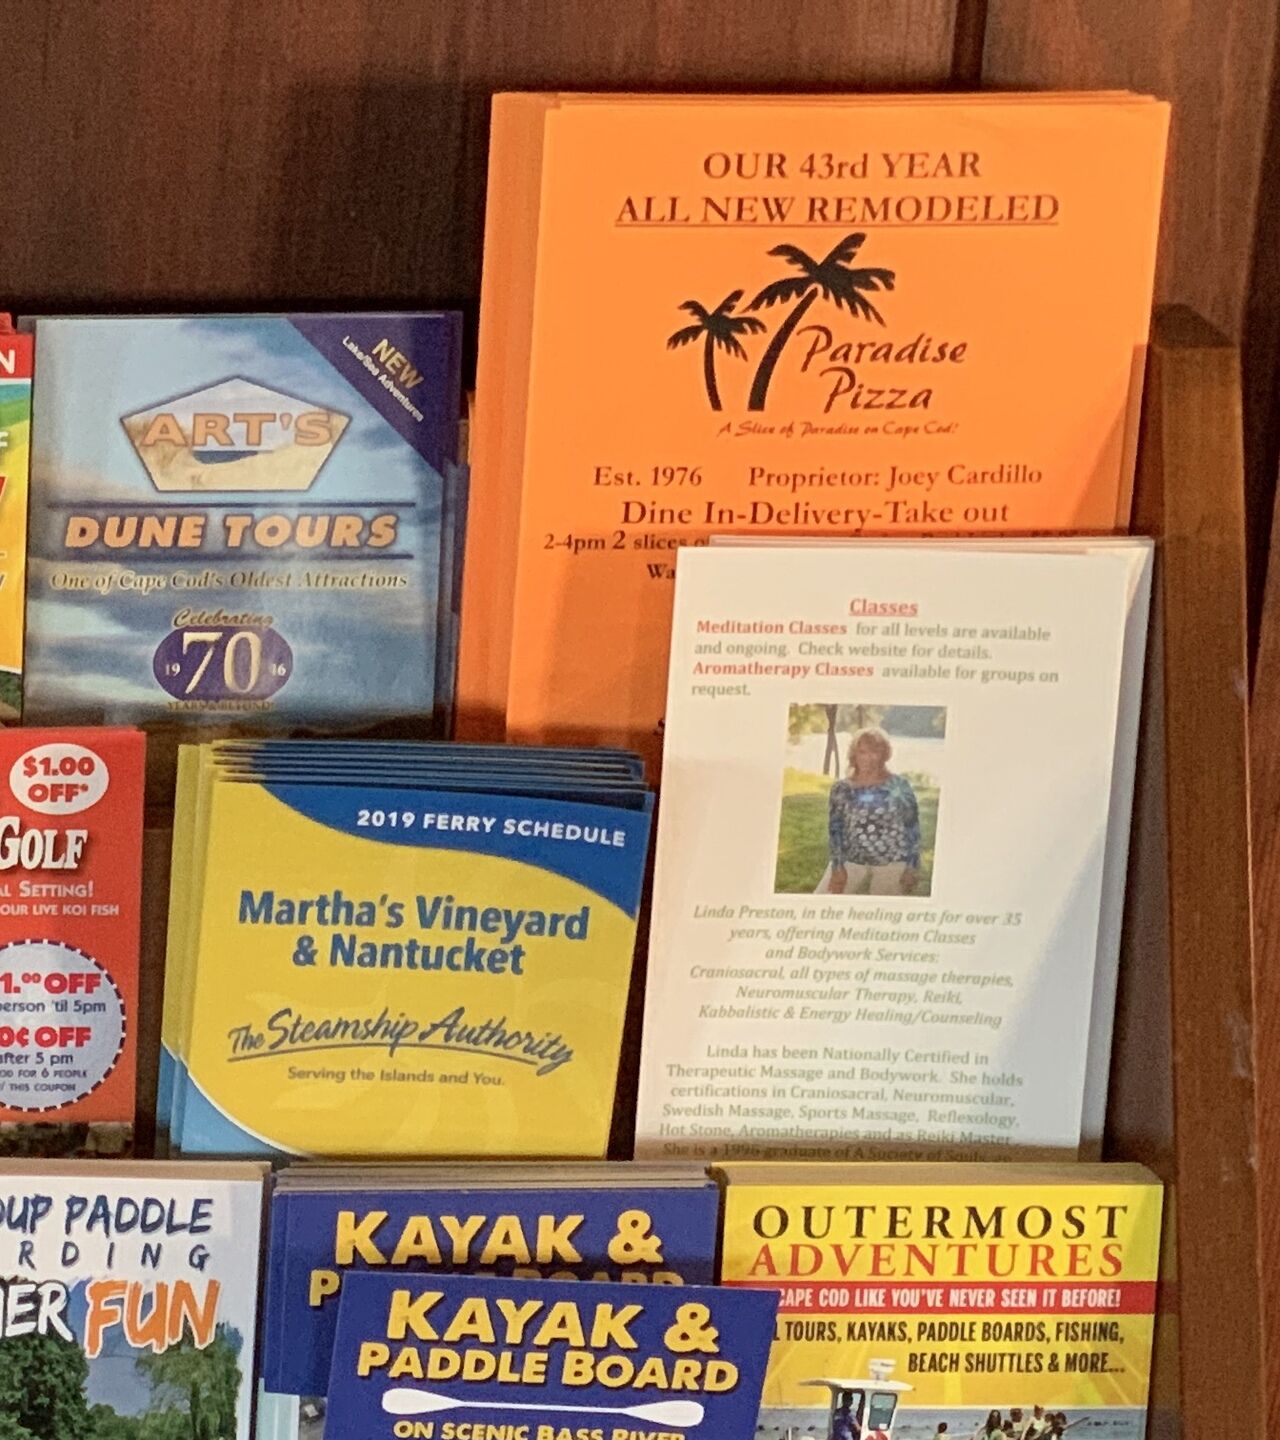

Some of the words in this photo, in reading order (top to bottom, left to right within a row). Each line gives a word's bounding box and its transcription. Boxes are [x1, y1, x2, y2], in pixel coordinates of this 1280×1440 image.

[371, 338, 423, 390] NEW
[796, 325, 967, 371] Paradise
[819, 366, 932, 413] Pizza
[143, 413, 334, 447] ART'S
[594, 466, 641, 487] Est.
[652, 465, 702, 486] 1976
[749, 465, 880, 491] Proprietor:
[886, 465, 940, 490] Joey
[947, 464, 1042, 485] Cardillo
[65, 515, 206, 549] DUNE
[226, 515, 399, 548] TOURS
[850, 598, 918, 617] Classes
[23, 757, 95, 777] $1.00
[357, 810, 415, 828] 2019
[423, 814, 496, 832] FERRY
[503, 818, 625, 847] SCHEDULE
[239, 890, 405, 926] Martha's
[416, 896, 590, 944] Vineyard
[292, 935, 316, 967] &
[330, 934, 525, 975] Nantucket
[65, 1195, 213, 1236] PADDLE
[753, 1205, 1128, 1239] OUTERMOST
[748, 1244, 1124, 1277] ADVENTURES
[84, 1279, 222, 1358] FUN
[387, 1289, 643, 1349] KAYAK
[663, 1303, 720, 1354] &
[357, 1342, 546, 1384] PADDLE
[561, 1352, 738, 1392] BOARD
[908, 1353, 959, 1372] BEACH
[964, 1353, 1043, 1372] SHUTTLES
[1048, 1354, 1058, 1372] &
